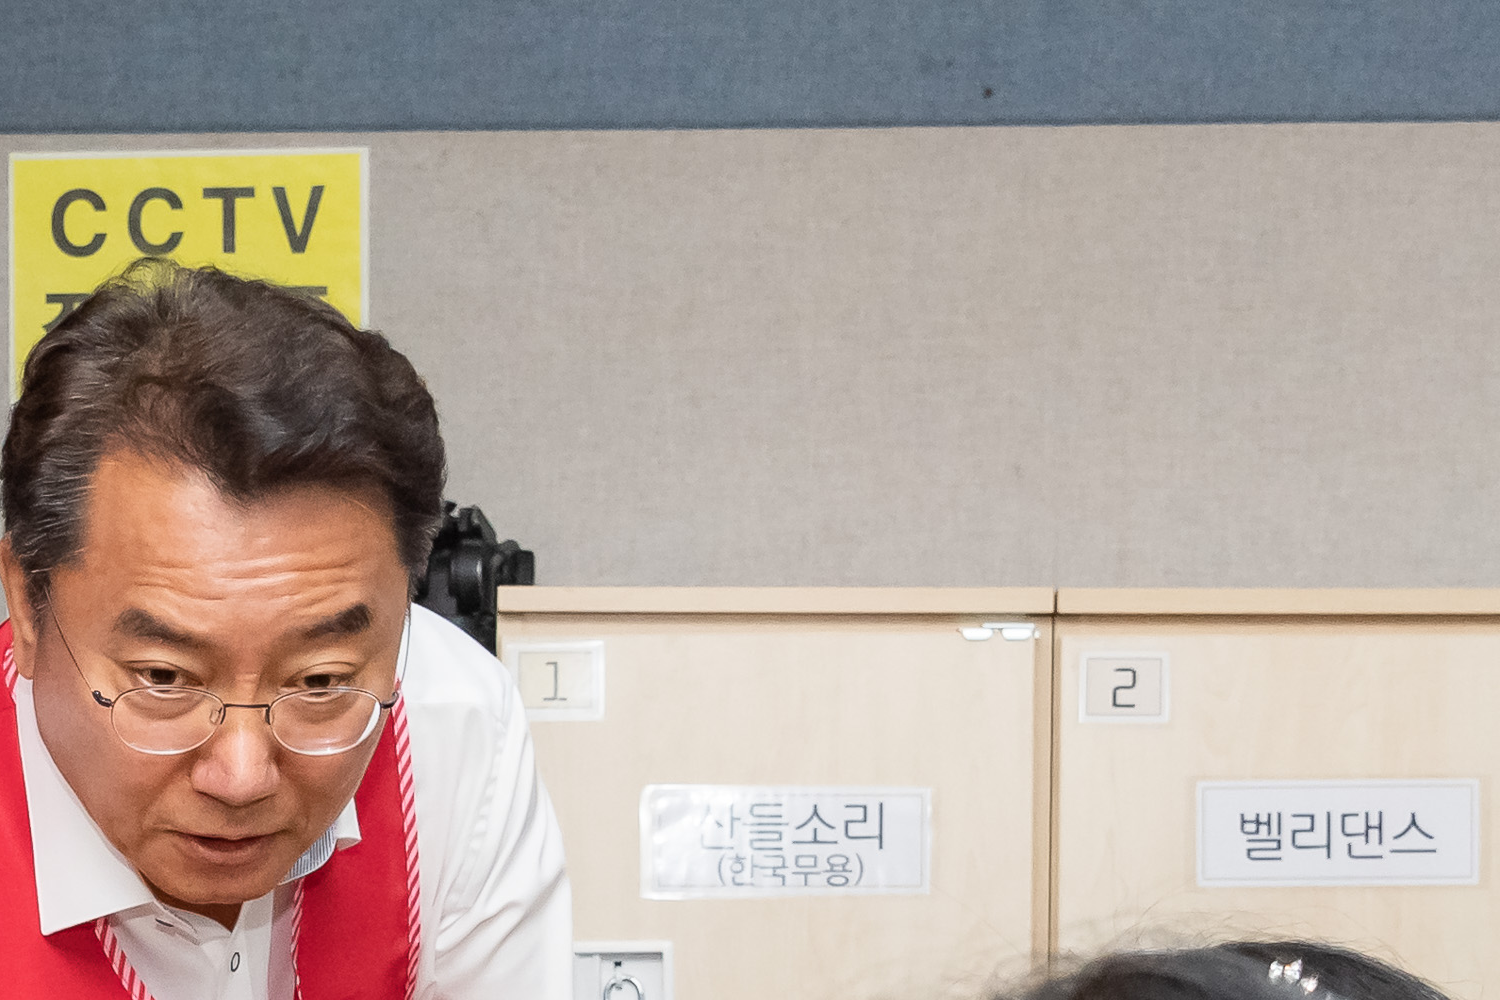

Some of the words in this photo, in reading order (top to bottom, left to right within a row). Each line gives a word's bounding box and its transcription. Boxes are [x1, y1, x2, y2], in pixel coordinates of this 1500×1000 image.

[50, 184, 326, 258] CCTV
[542, 661, 568, 702] 1
[1111, 667, 1137, 708] 2
[700, 802, 884, 851] 산들소리
[1239, 810, 1438, 861] 벨리댄스
[717, 853, 864, 887] (한국무용)
